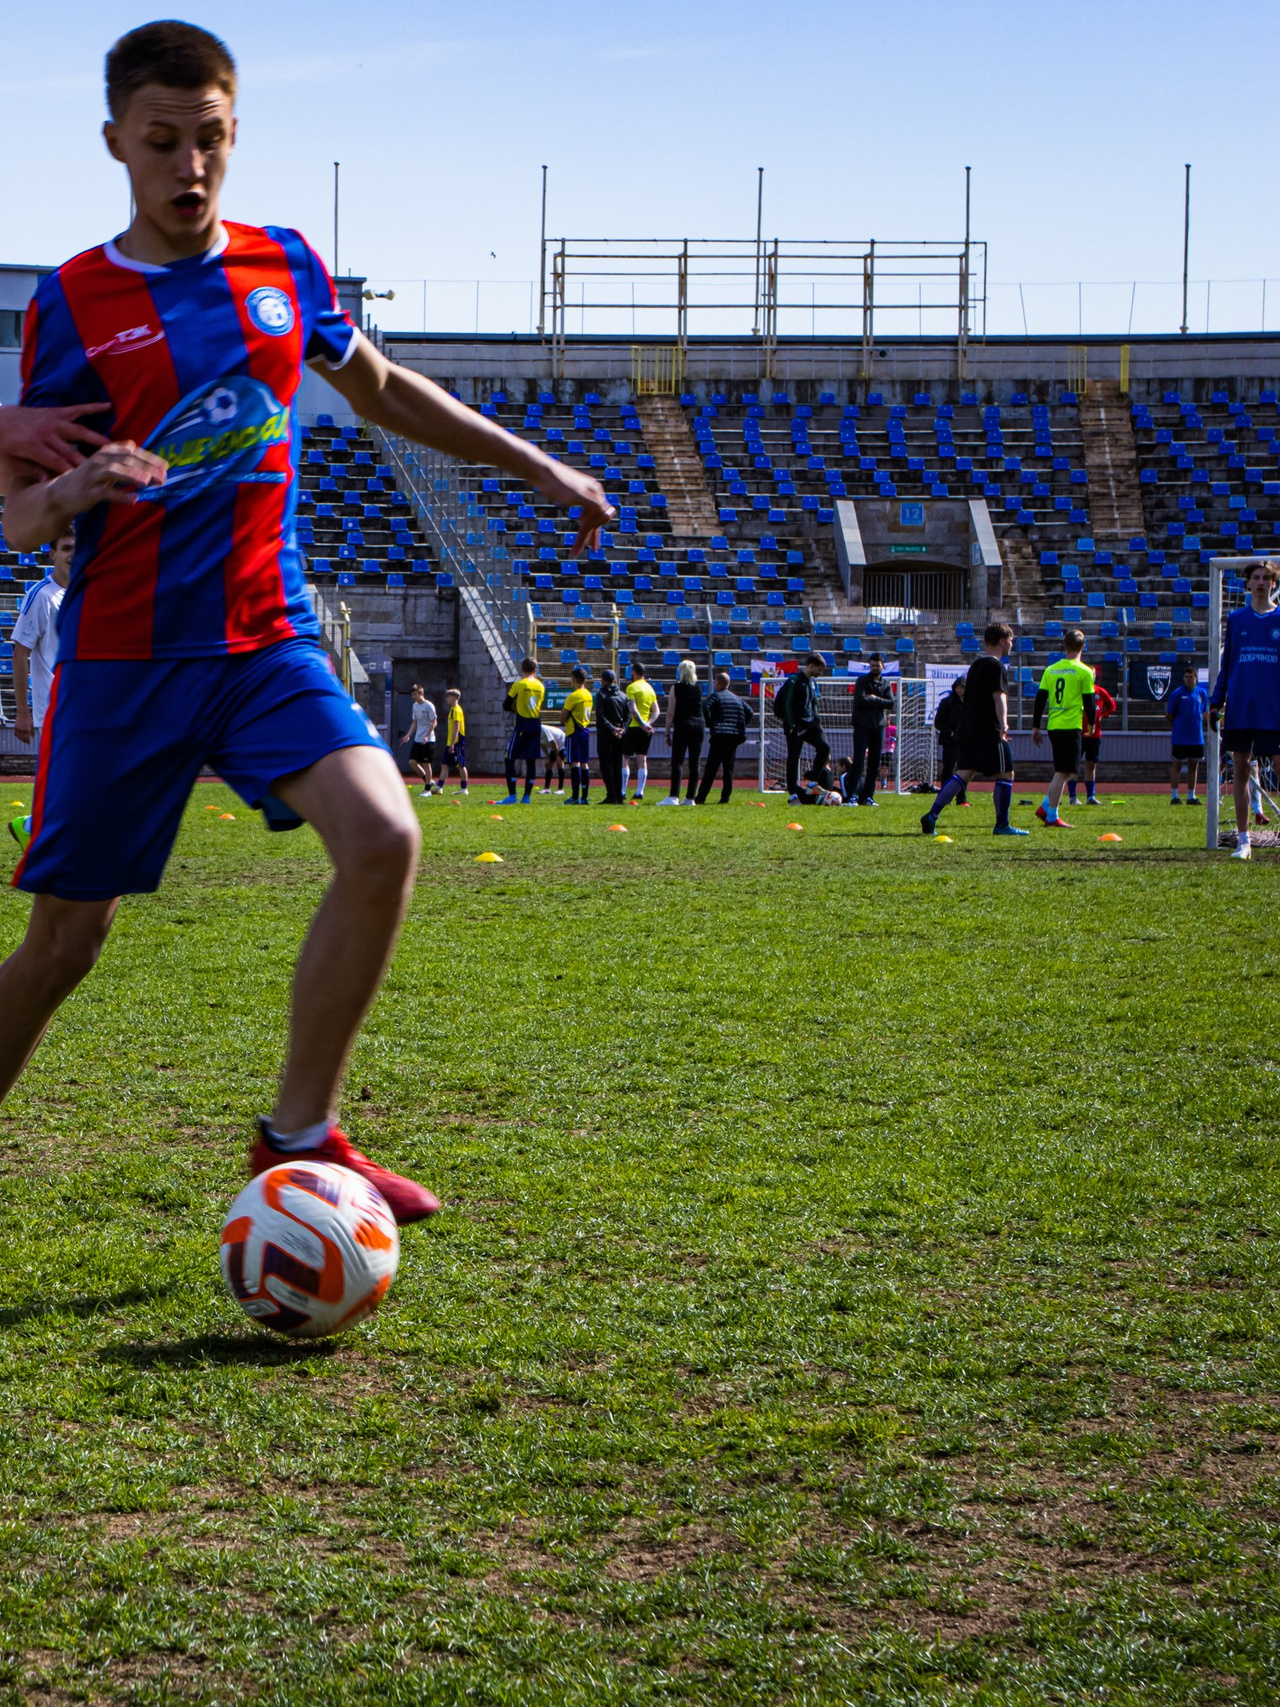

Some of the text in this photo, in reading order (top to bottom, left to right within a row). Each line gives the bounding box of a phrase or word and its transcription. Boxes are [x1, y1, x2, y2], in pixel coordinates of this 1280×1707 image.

[904, 508, 920, 519] 12
[1239, 653, 1278, 664] ДОБРЯКОВ
[1055, 677, 1066, 705] 8
